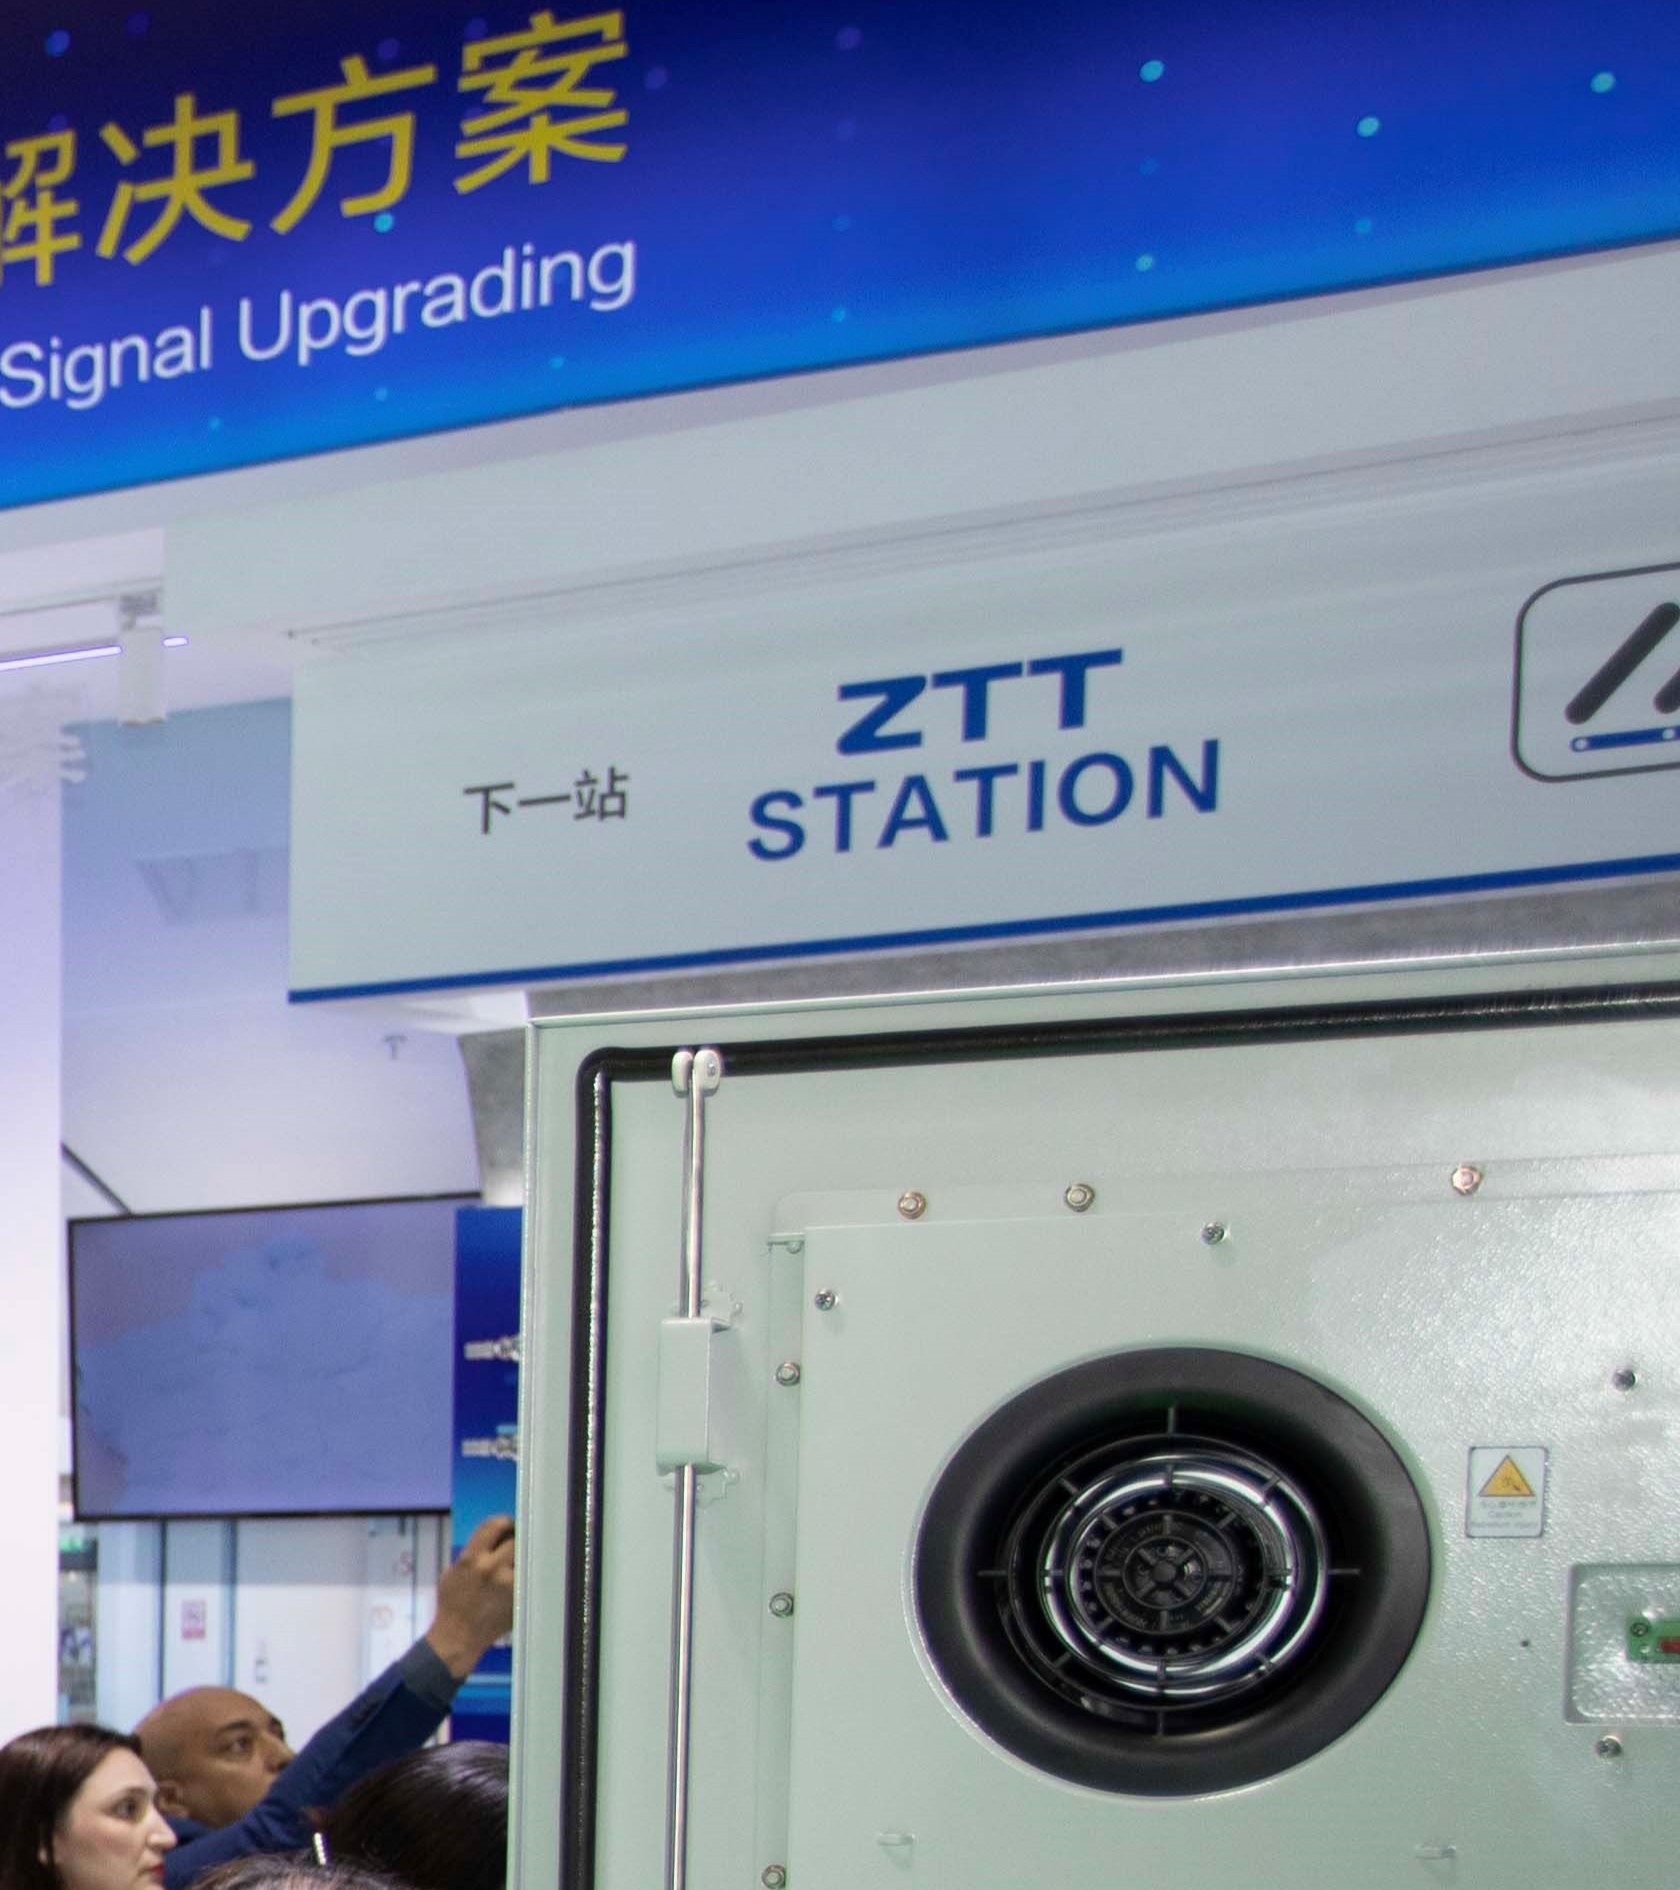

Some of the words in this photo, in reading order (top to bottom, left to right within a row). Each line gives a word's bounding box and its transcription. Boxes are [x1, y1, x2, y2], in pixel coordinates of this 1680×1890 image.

[237, 240, 639, 368] Upgrading
[836, 646, 1125, 758] ZTT
[460, 766, 631, 838] 下一站
[745, 735, 1223, 864] STATION
